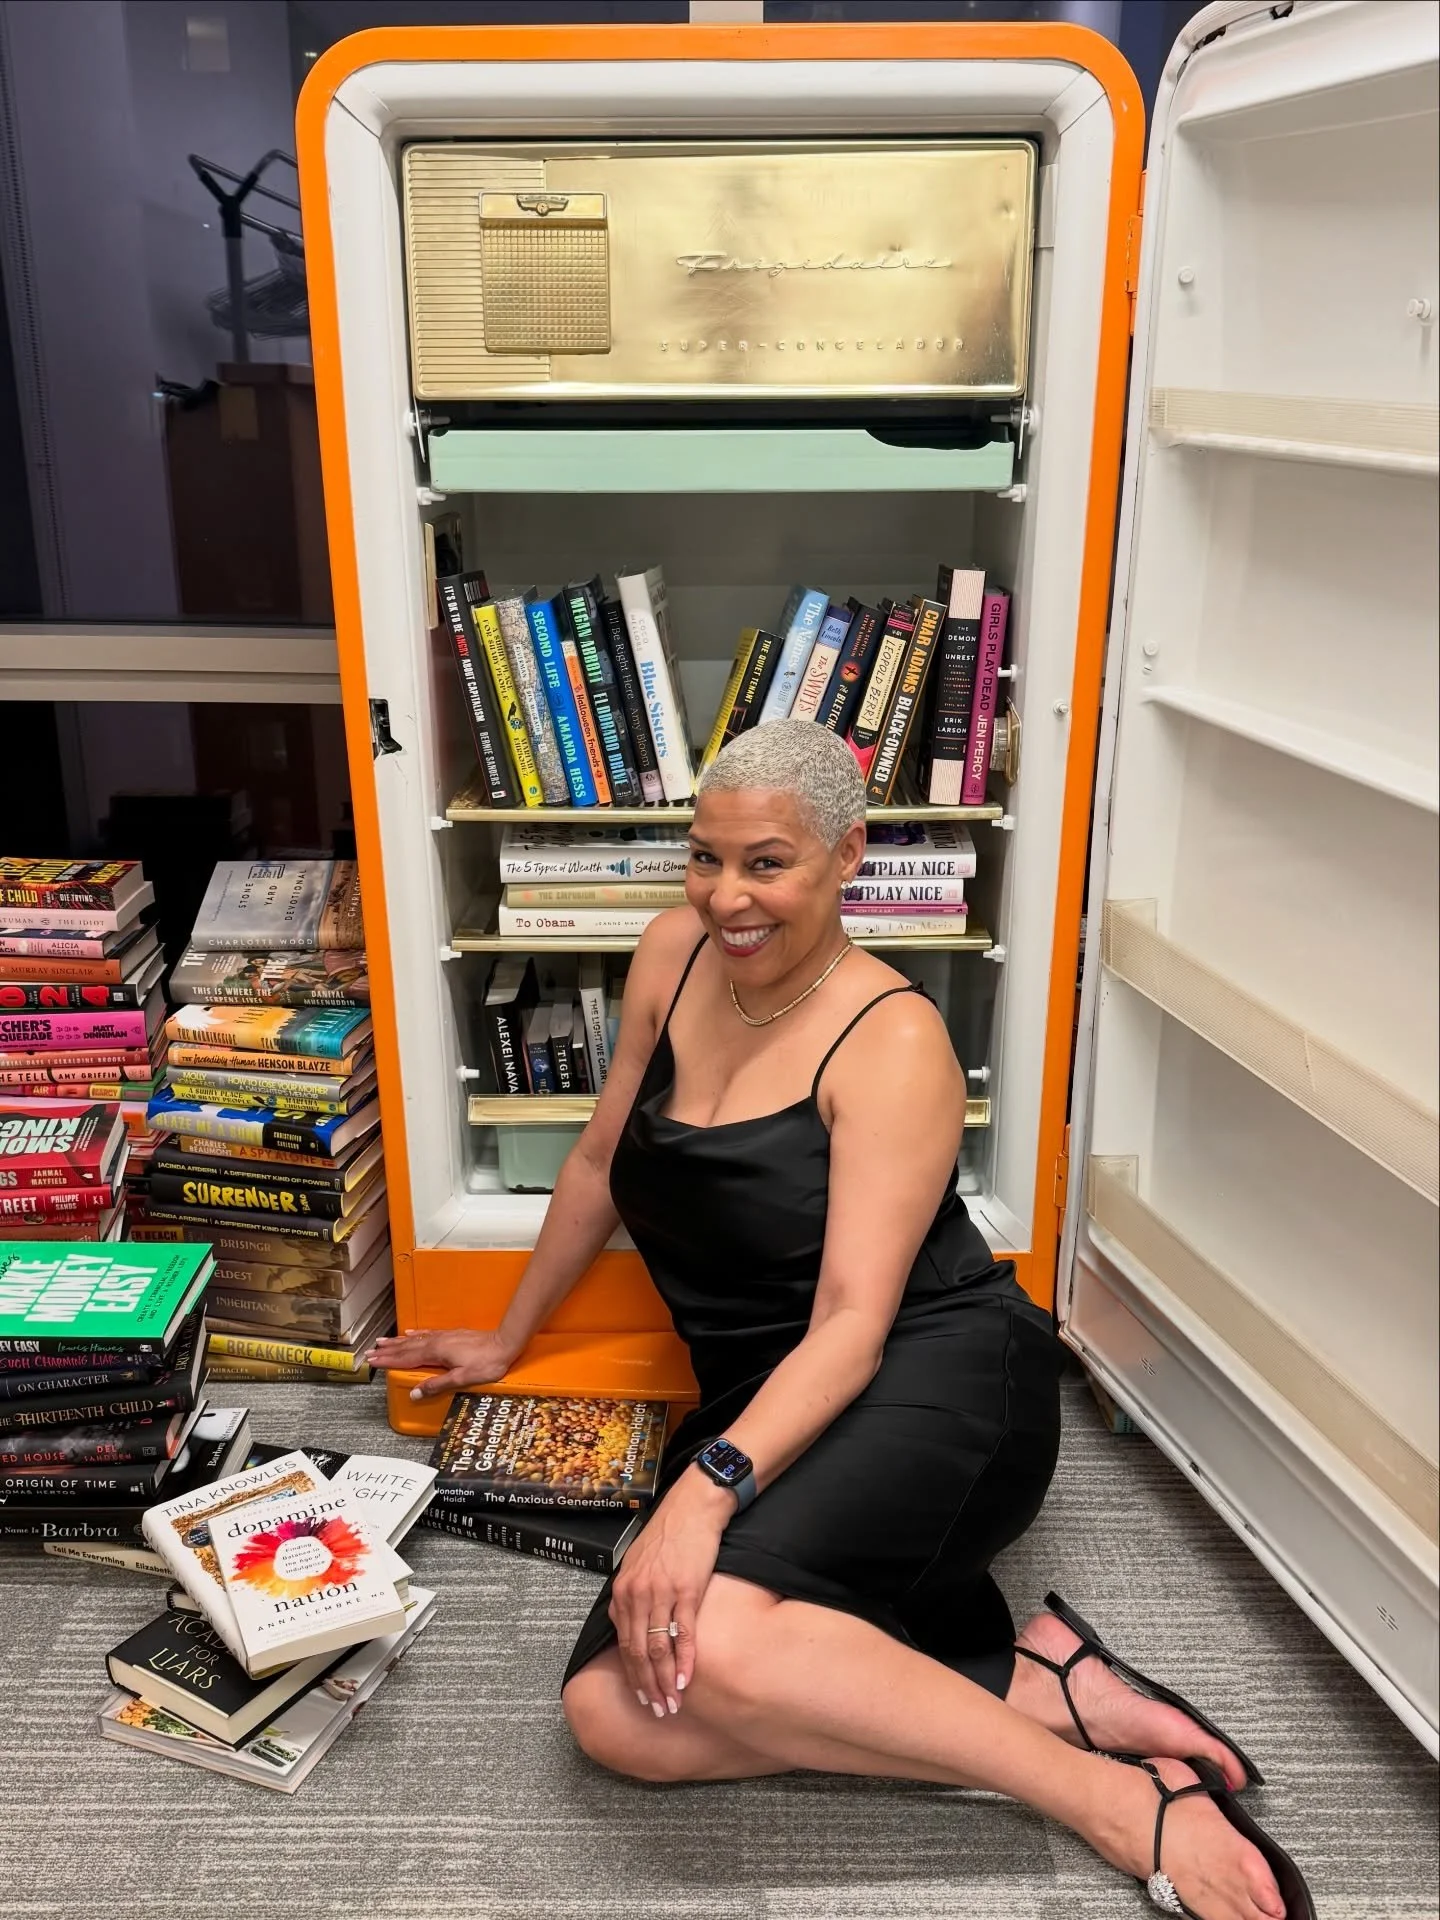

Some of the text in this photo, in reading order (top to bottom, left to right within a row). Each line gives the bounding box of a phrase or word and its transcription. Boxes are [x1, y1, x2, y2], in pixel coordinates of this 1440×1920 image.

[675, 249, 953, 277] Frigidaire
[660, 339, 967, 352] SUPER-CONGELADOR
[570, 597, 603, 683] MEGAN ABBOTT
[788, 602, 822, 668] The Names
[532, 611, 560, 689] SECOND LIFE
[902, 609, 939, 694] CHAR ADAMS
[980, 603, 1001, 711] GIRLS PLAY DEAD
[616, 644, 635, 700] Right Here
[745, 640, 772, 704] THE QUIET TENANT
[875, 640, 896, 685] LEOPOLD
[456, 634, 486, 723] ANGRY ABOUT CAPITALISM
[799, 668, 828, 714] SWIFTS
[640, 661, 669, 758] Blue Sisters
[861, 686, 882, 726] BERRY
[630, 708, 650, 767] Amy Bloom
[874, 696, 913, 783] BLACK-OWNED
[937, 726, 967, 734] LARSON
[557, 716, 586, 798] AMANDA HESS
[972, 715, 989, 781] JEN PERCY
[480, 732, 500, 786] BERNIE SANDERS
[608, 753, 628, 786] DRIVE
[506, 860, 603, 876] The 5 Types Wealth
[635, 860, 660, 874] Sahil
[880, 862, 955, 876] PLAY NICE
[8, 889, 38, 903] CHILD
[72, 894, 93, 902] TRYING
[239, 882, 254, 908] STONE
[264, 885, 278, 906] YARD
[285, 869, 307, 921] DEVOTIONAL
[866, 886, 943, 901] PLAY NICE
[516, 918, 575, 928] To Obama
[192, 987, 272, 997] THIS IS WHERE THE
[311, 990, 345, 999] DANIYAL
[83, 1031, 127, 1039] DINNIMAN
[193, 1030, 237, 1046] MORNINGSIDE
[592, 1017, 602, 1041] LIGHT
[193, 1054, 331, 1072] Incredibly Human HENSON BLAYZE
[496, 1017, 520, 1094] ALEXEI NAVA
[18, 1073, 46, 1082] TELL
[182, 1072, 207, 1081] MOLLY
[558, 1050, 570, 1089] TIGER
[298, 1084, 328, 1094] MOTHER
[155, 1115, 192, 1130] BLAZE
[189, 1146, 232, 1156] BEAUMONT
[193, 1139, 227, 1149] CHARLES
[250, 1148, 316, 1165] SPY ALONE
[158, 1162, 186, 1172] JACINDA
[230, 1171, 330, 1187] DIFFERENT POWER
[51, 1194, 80, 1204] PHILIPPE
[183, 1181, 298, 1213] SURRENDER
[221, 1220, 319, 1237] DIFFERENT POWER
[220, 1238, 271, 1252] BRISINGR
[214, 1269, 252, 1280] ELDEST
[24, 1254, 114, 1322] MONEY
[84, 1264, 158, 1313] EASY
[216, 1296, 282, 1314] INHERITANCE
[15, 1340, 40, 1352] EASY
[226, 1340, 313, 1365] BREAKNECK
[0, 1353, 120, 1369] SUCH CHARMING LIARS
[17, 1374, 110, 1393] ON CHARACTER
[15, 1401, 153, 1426] THIRTEENTH CHILD
[630, 1404, 647, 1430] Haidt
[451, 1396, 493, 1473] The Anxious
[475, 1400, 513, 1471] Generation
[24, 1452, 65, 1462] HOUSE
[97, 1444, 117, 1453] DEL
[207, 1440, 225, 1467] Barbra
[620, 1431, 641, 1480] Jonathan
[5, 1477, 117, 1488] ORIGIN OF TIME
[162, 1498, 207, 1517] TINA
[208, 1461, 297, 1499] KNOWLES
[346, 1471, 418, 1491] WHITE
[436, 1488, 475, 1496] Jonathan
[484, 1493, 623, 1508] The Anxious Generation
[227, 1497, 347, 1539] dopamine
[462, 1516, 473, 1528] NO
[41, 1522, 120, 1538] Barbra
[282, 1550, 311, 1560] Balance
[286, 1543, 312, 1553] Finding
[545, 1537, 574, 1553] BRIAN
[53, 1545, 125, 1566] Tell Everything
[534, 1548, 587, 1568] GOLDSTONE
[135, 1562, 172, 1575] Elizabeth
[286, 1561, 326, 1574] Indulgence
[273, 1582, 358, 1614] nation
[258, 1616, 297, 1631] ANNA
[306, 1598, 361, 1618] LEMBKE
[168, 1614, 233, 1653] ACAD
[186, 1644, 220, 1667] FOR
[148, 1647, 223, 1690] LIARS
